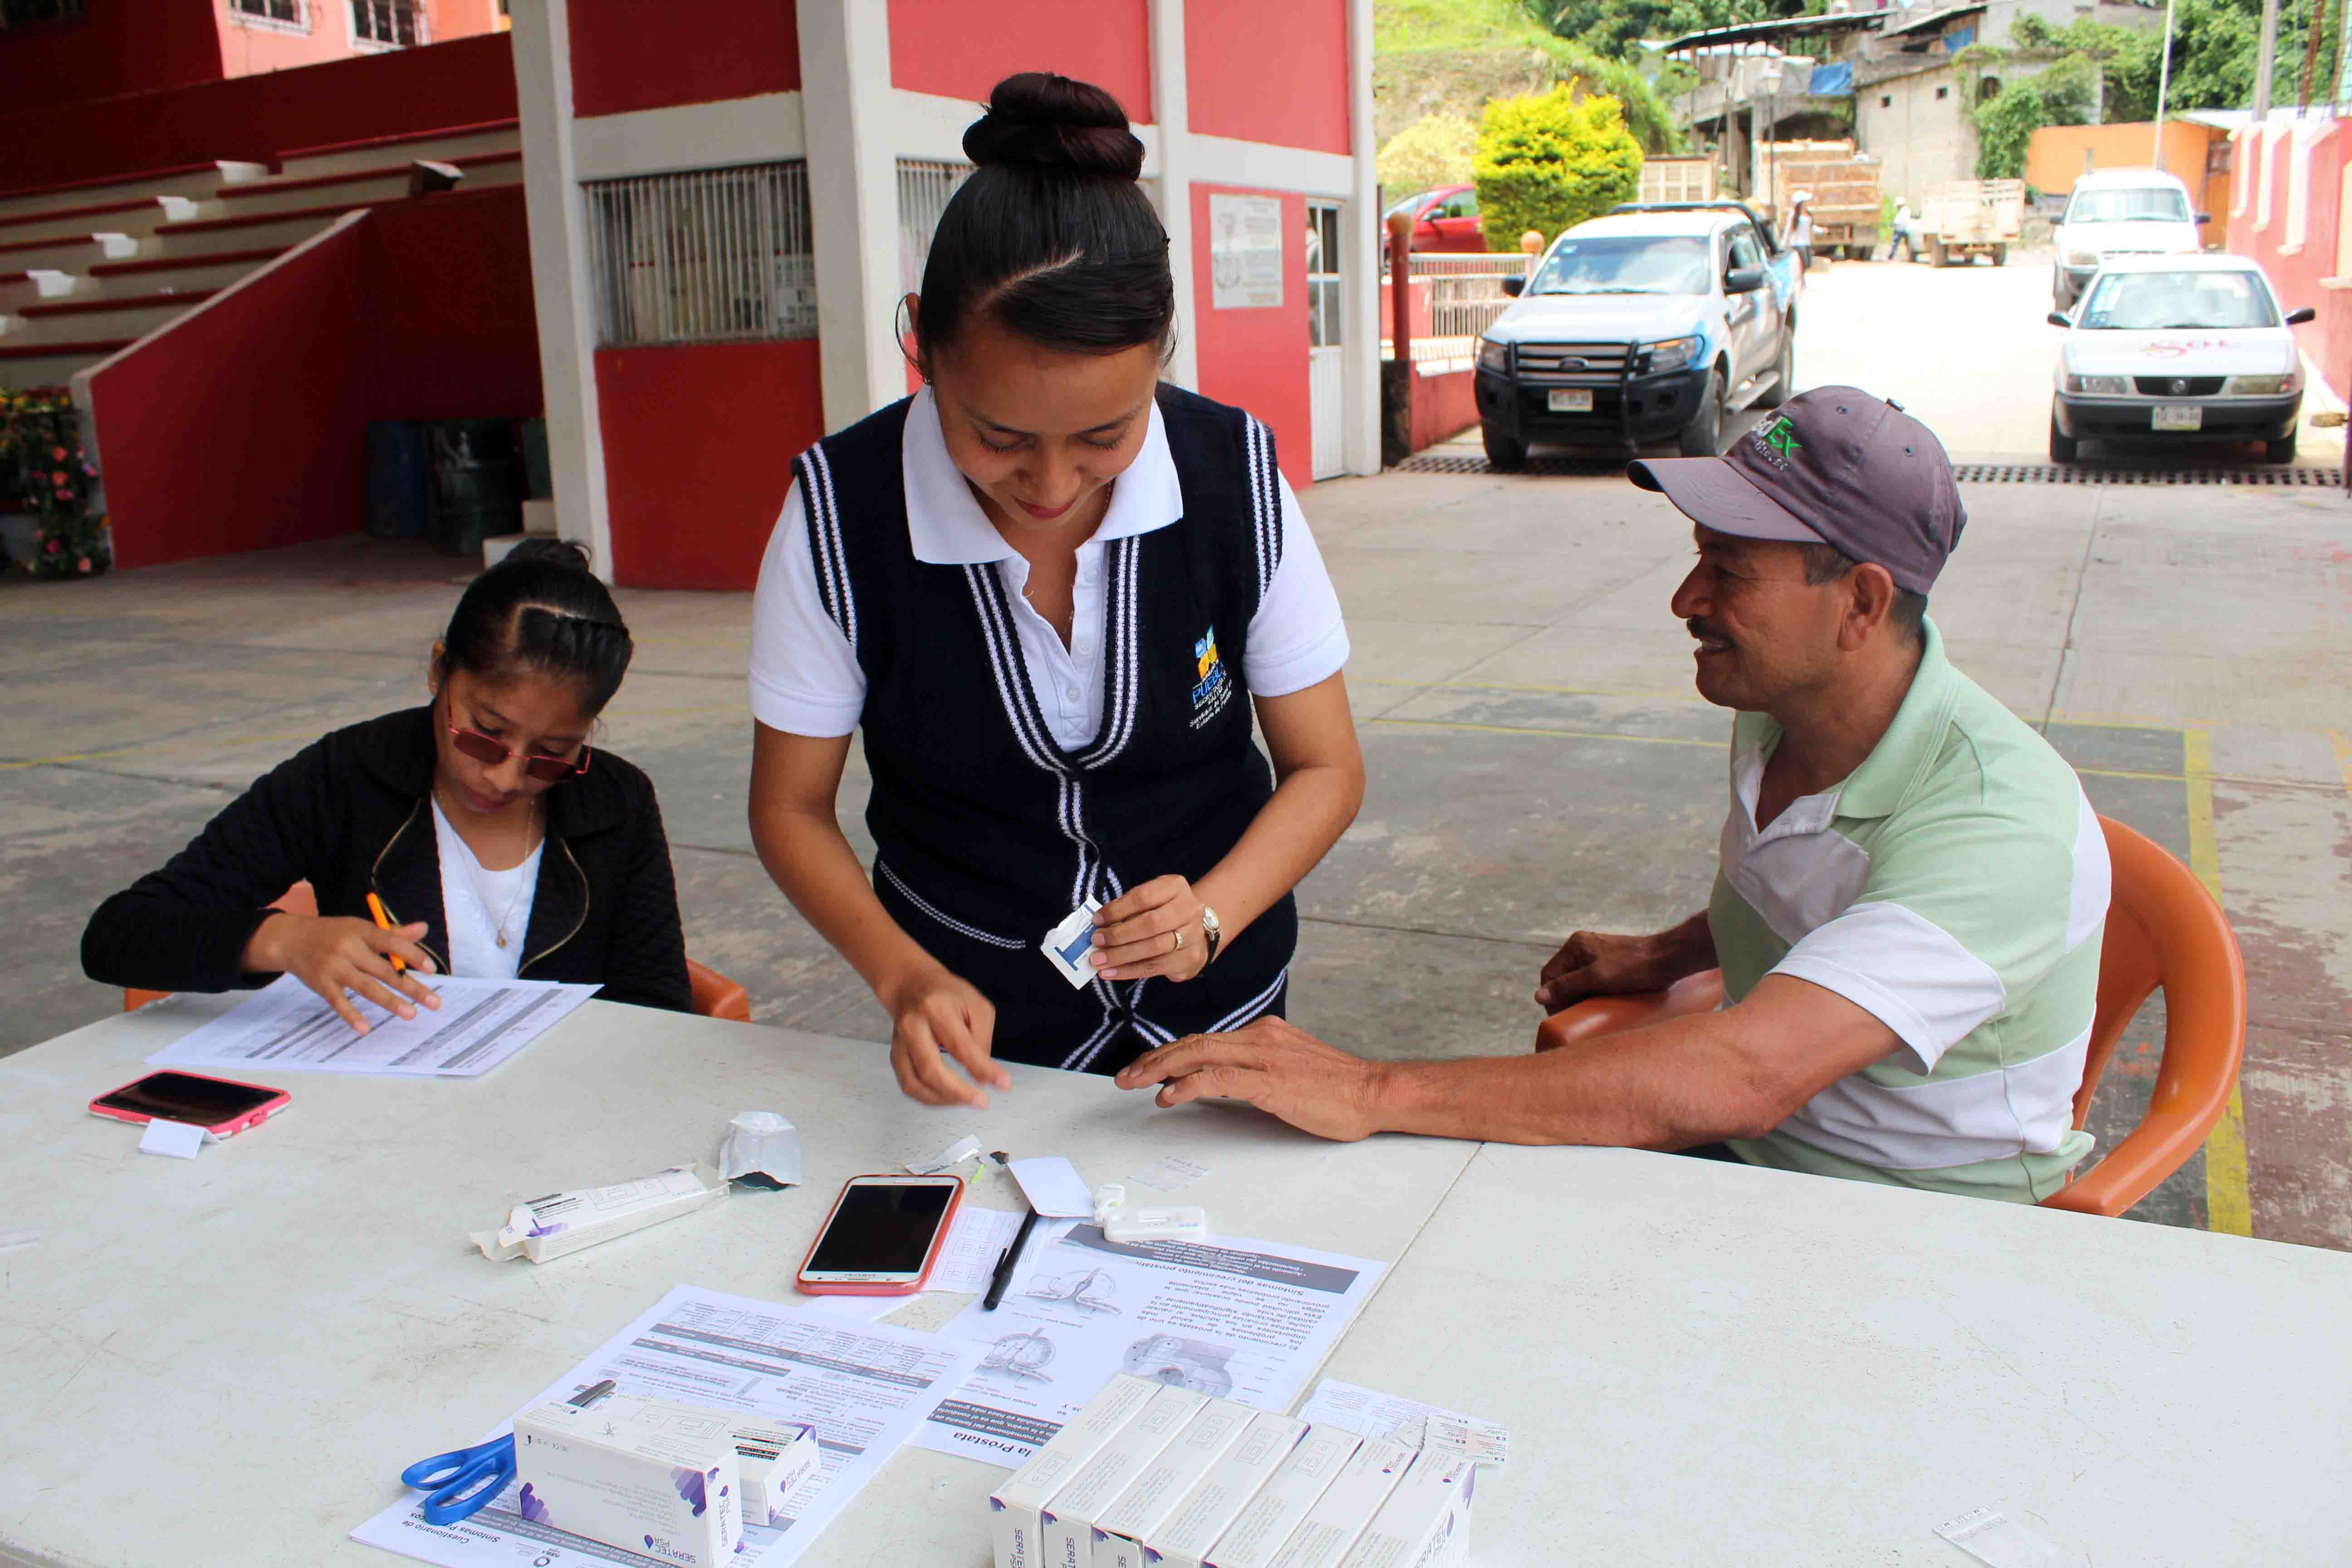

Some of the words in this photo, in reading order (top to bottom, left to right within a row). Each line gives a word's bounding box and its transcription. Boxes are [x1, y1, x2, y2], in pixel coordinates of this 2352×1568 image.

[1178, 1268, 1235, 1281] crecimiento
[1238, 1335, 1286, 1347] crecimiento
[953, 1432, 1014, 1453] Próstata
[1017, 1447, 1031, 1457] la
[415, 1524, 470, 1544] Cuestionario
[719, 1500, 728, 1548] SERATEC
[654, 1537, 670, 1547] PSA
[1015, 1528, 1024, 1568] SERATE
[654, 1544, 696, 1564] SERATEC
